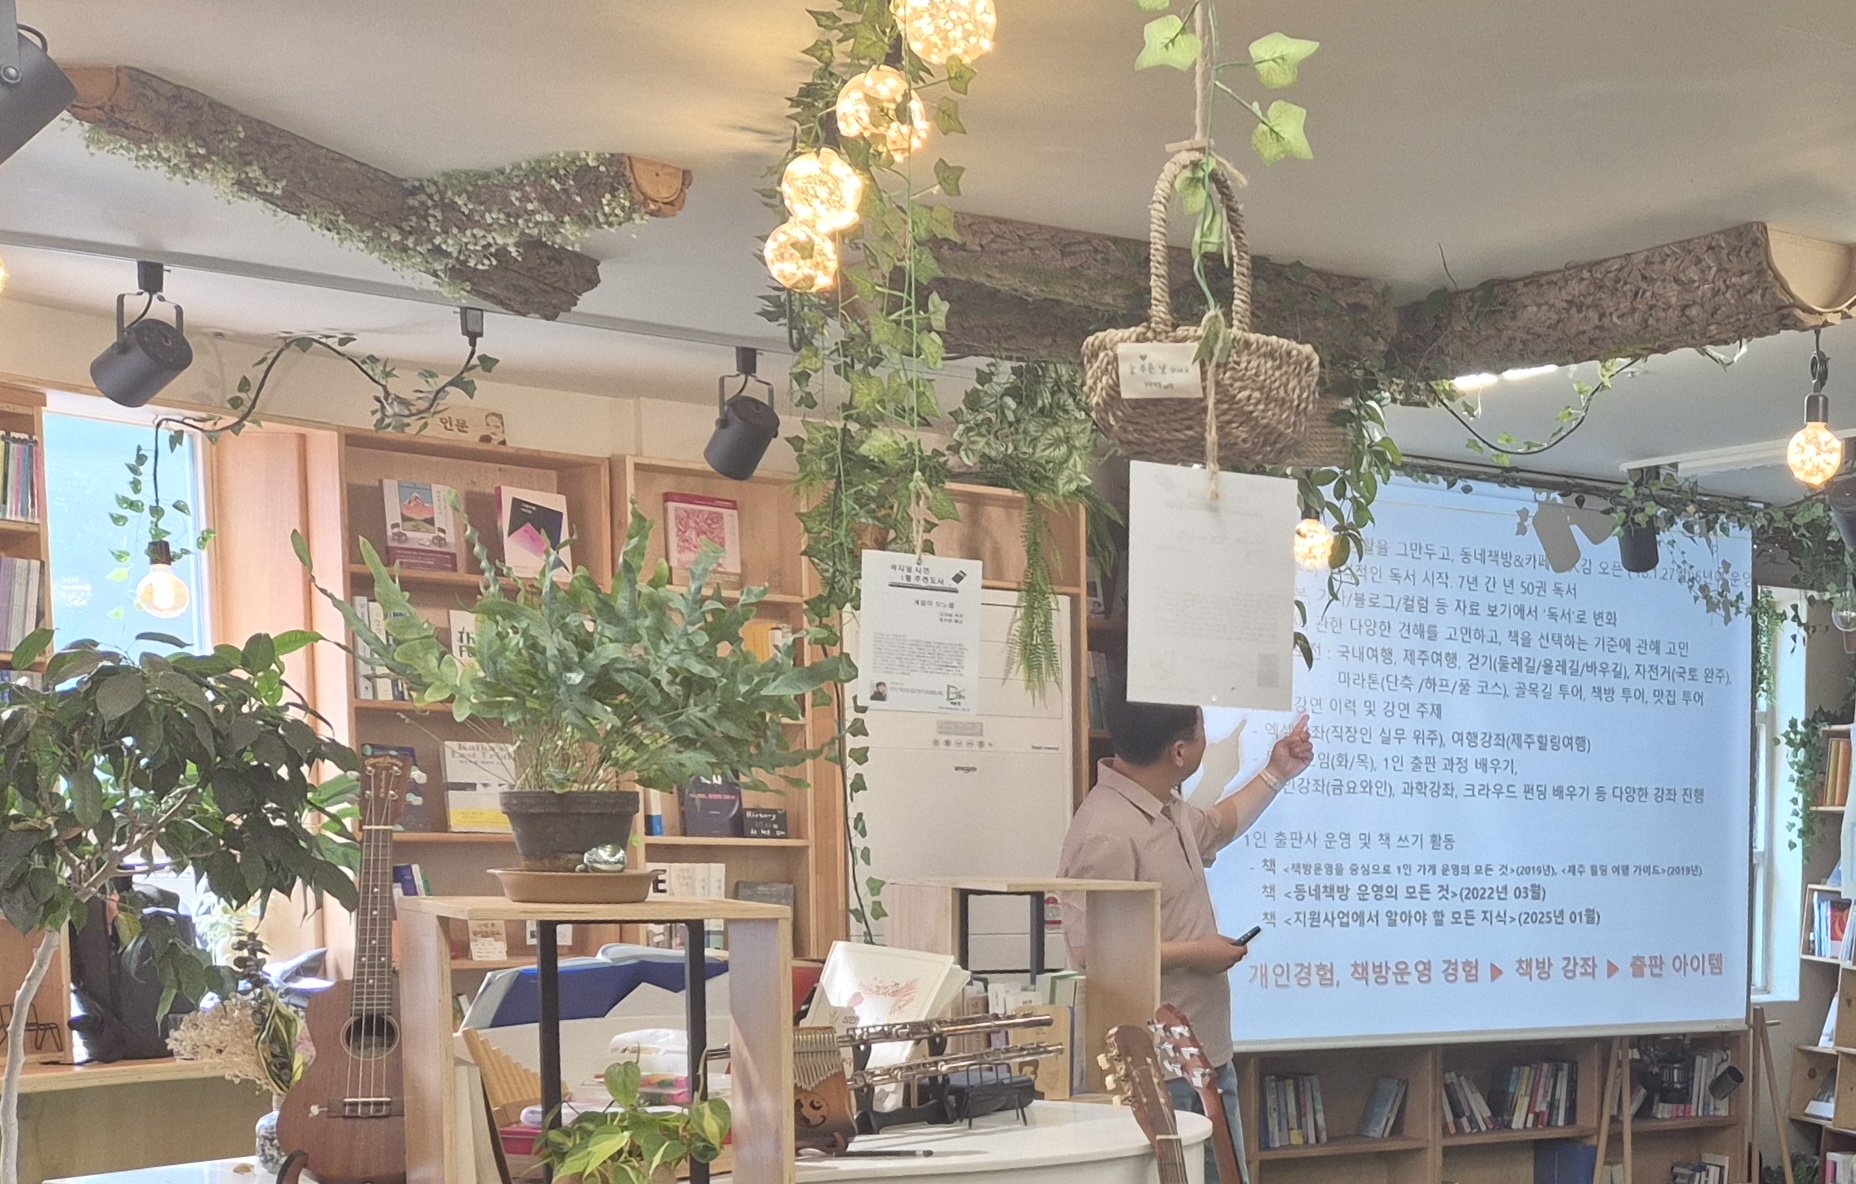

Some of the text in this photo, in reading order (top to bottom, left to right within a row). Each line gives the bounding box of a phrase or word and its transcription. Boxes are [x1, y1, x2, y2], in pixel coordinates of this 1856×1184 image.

[438, 415, 470, 434] 인문
[1395, 541, 1455, 564] 그만두고,
[1389, 567, 1416, 587] 독서
[1422, 571, 1454, 590] 시작.
[1457, 574, 1479, 592] 7년
[1485, 577, 1497, 593] 간
[1503, 578, 1515, 595] 년
[1520, 579, 1547, 598] 50권
[1552, 582, 1578, 600] 독서
[1435, 597, 1449, 615] 등
[1454, 599, 1482, 618] 자료
[1487, 602, 1539, 622] 보기에서
[1593, 610, 1618, 628] 변화
[1315, 616, 1343, 636] 관한
[1350, 617, 1392, 638] 다양한
[1398, 622, 1439, 642] 견해를
[1445, 626, 1502, 647] 고민하고,
[1507, 629, 1532, 648] 책을
[1538, 631, 1589, 651] 선택하는
[1594, 636, 1631, 656] 기준에
[1666, 640, 1690, 659] 고민
[1336, 644, 1398, 667] 국내여행,
[1402, 649, 1461, 670] 제주여행,
[1634, 662, 1699, 684] 자전거(국토
[1703, 667, 1733, 687] 완주),
[1338, 671, 1414, 693] 마라톤(단축
[1476, 679, 1509, 699] 코스),
[1514, 681, 1553, 701] 골목길
[1557, 684, 1586, 703] 투어,
[1591, 685, 1615, 703] 책방
[1620, 686, 1649, 705] 투어,
[1653, 688, 1677, 706] 맛집
[1682, 690, 1705, 708] 투어
[1293, 696, 1443, 721] 강연 이력 및 강연 주제
[1379, 726, 1407, 746] 실무
[1412, 728, 1446, 748] 위주),
[1383, 754, 1405, 772] 1인
[1409, 754, 1437, 773] 출판
[1441, 755, 1469, 774] 과정
[1474, 757, 1518, 776] 배우기,
[1400, 779, 1458, 800] 과학강좌,
[1463, 782, 1518, 800] 크라우드
[1523, 783, 1547, 801] 펀딩
[1552, 785, 1590, 802] 배우기
[1594, 786, 1607, 802] 등
[1611, 786, 1649, 803] 다양한
[1653, 786, 1677, 804] 강좌
[1681, 787, 1705, 804] 진행
[1243, 830, 1456, 850] 1인 출판사 운영 및 책 쓰기 활동
[1261, 857, 1277, 875] 책
[1261, 884, 1276, 901] 책
[1284, 884, 1350, 901] <동네책방
[1356, 884, 1399, 901] 운영의
[1404, 884, 1432, 901] 모든
[1513, 883, 1546, 902] 03월)
[1261, 911, 1277, 928] 책
[1283, 911, 1380, 928] <지원사업에서
[1385, 910, 1427, 928] 알아야
[1432, 910, 1446, 927] 할
[1450, 910, 1477, 927] 모든
[1569, 907, 1601, 926] 01월)
[1248, 952, 1724, 989] 개인경험, 책방운영 경험 책방 강좌 출판 아이템
